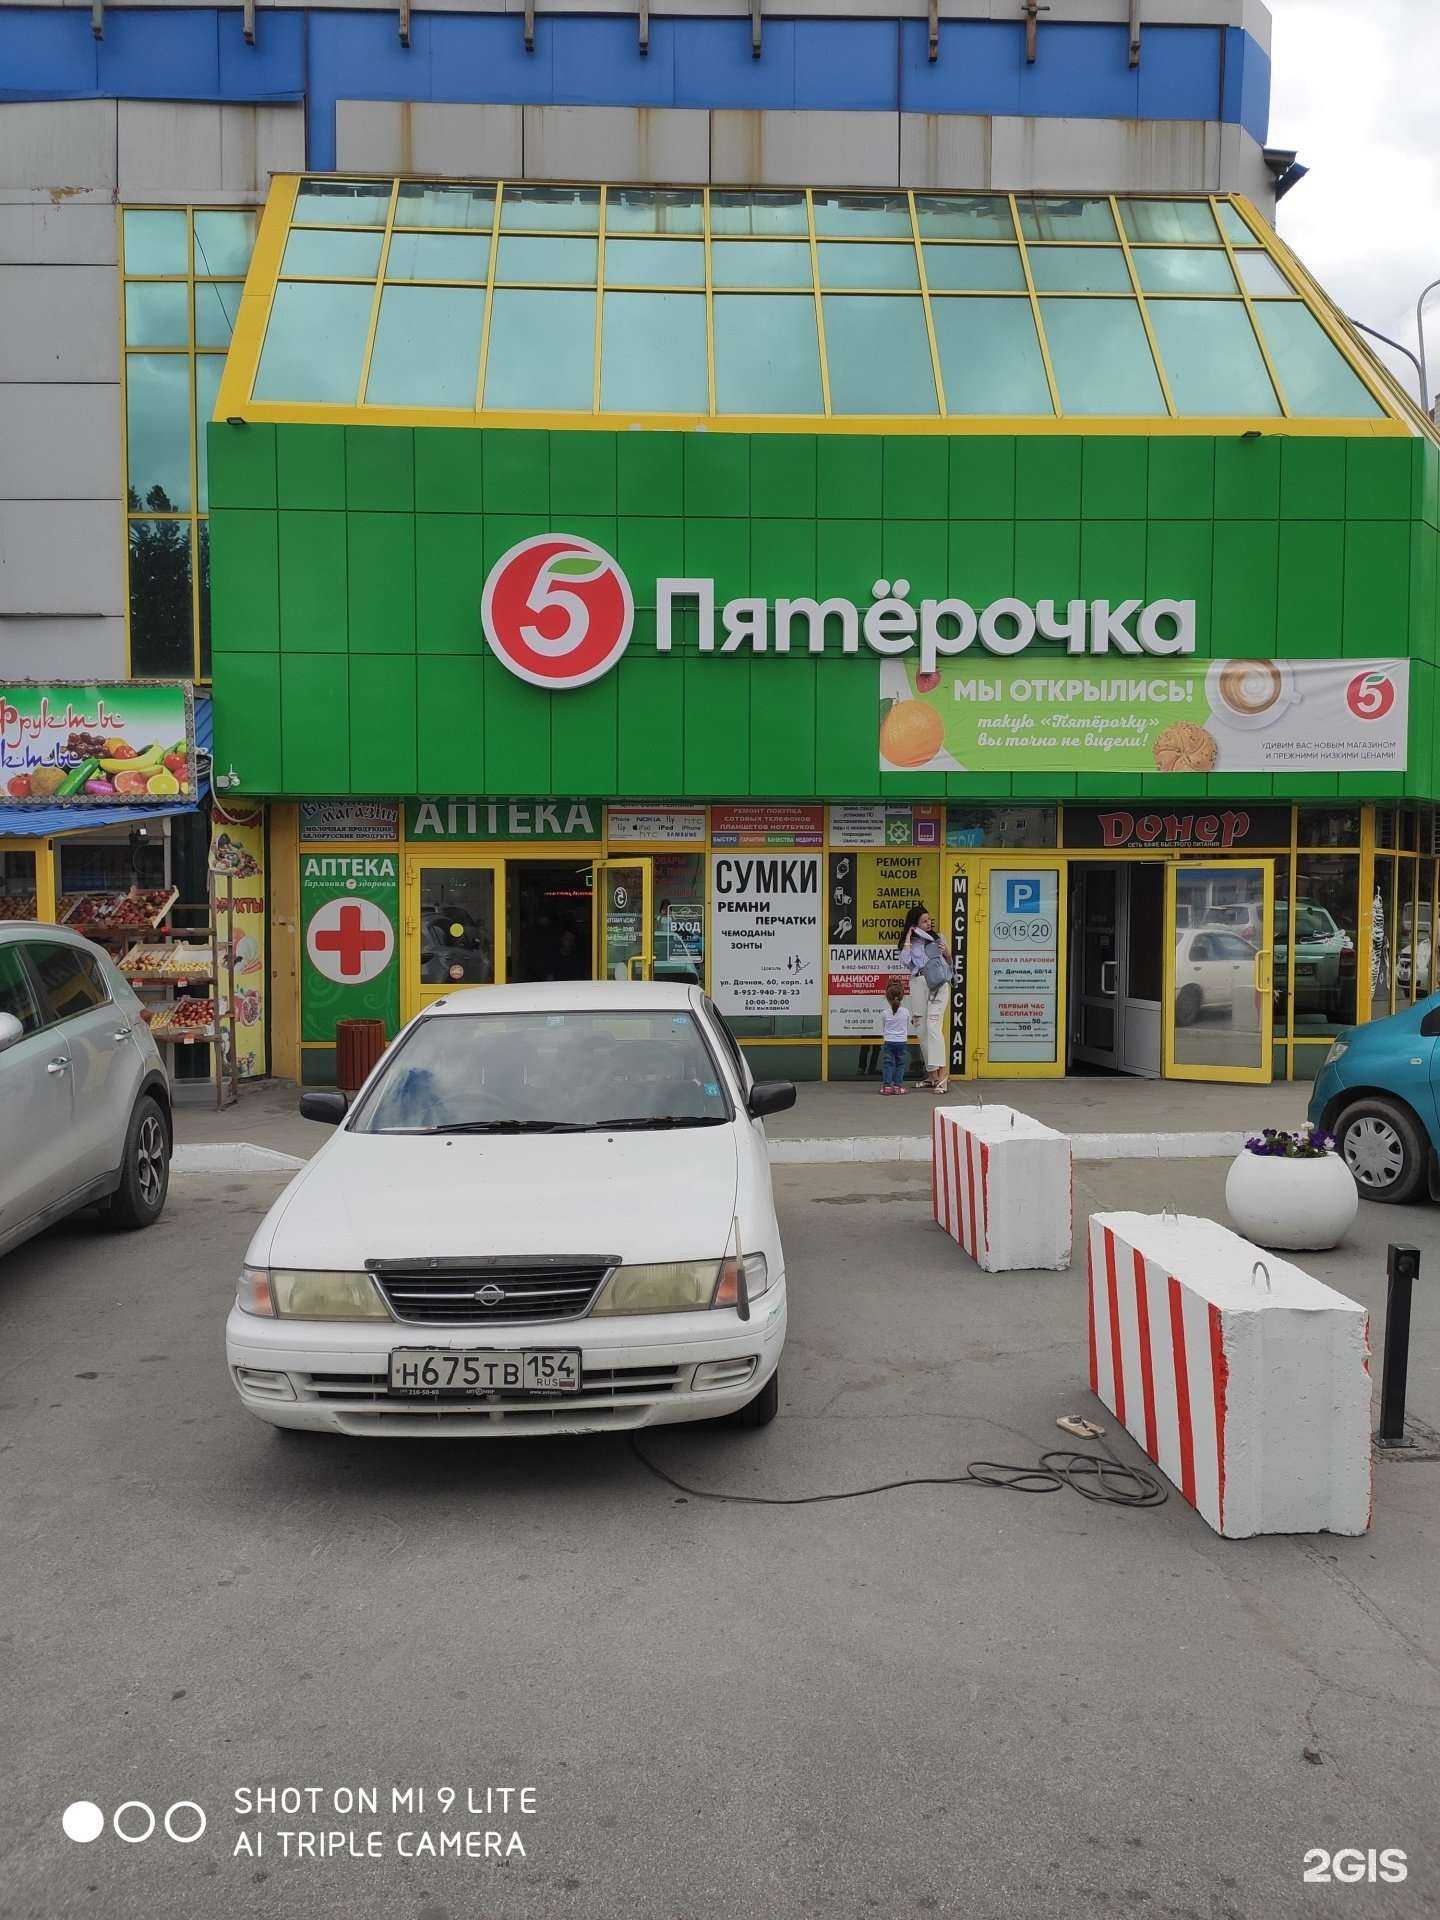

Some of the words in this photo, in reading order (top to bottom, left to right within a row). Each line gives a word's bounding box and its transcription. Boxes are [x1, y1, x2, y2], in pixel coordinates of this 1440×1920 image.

[655, 576, 1196, 674] Пятёрочка
[954, 680, 1000, 701] МЫ
[1009, 680, 1193, 702] ОТКРЫЛИСЬ!
[977, 714, 1035, 732] такую
[1040, 715, 1160, 732] «Пятёрочку»
[977, 733, 1002, 747] вы
[1006, 736, 1056, 747] точно
[1061, 736, 1081, 747] не
[1085, 733, 1149, 751] видели!
[1262, 742, 1294, 750] УДИВИМ
[414, 804, 594, 834] АПТЕКА
[1098, 811, 1250, 847] Донер
[304, 858, 395, 876] АПТЕКА
[876, 857, 922, 867] РЕМОНТ
[716, 860, 817, 893] СУМКИ
[880, 870, 918, 879] ЧАСОВ
[876, 888, 920, 897] ЗАМЕНА
[717, 901, 770, 912] РЕМНИ
[755, 916, 817, 925] ПЕРЧАТКИ
[862, 919, 936, 928] ИЗГОТОВЕ
[670, 921, 701, 933] ВХОД
[997, 926, 1009, 935] 10
[1013, 926, 1026, 936] 15
[1031, 924, 1049, 937] 20
[730, 942, 762, 950] ЗОНТЫ
[830, 949, 899, 961] ПАРИКМАХЕ
[952, 878, 967, 1065] МАСТЕРСКАЯ
[831, 975, 880, 983] МАНИКЮР
[527, 1356, 570, 1378] 154
[536, 1377, 558, 1387] RUS
